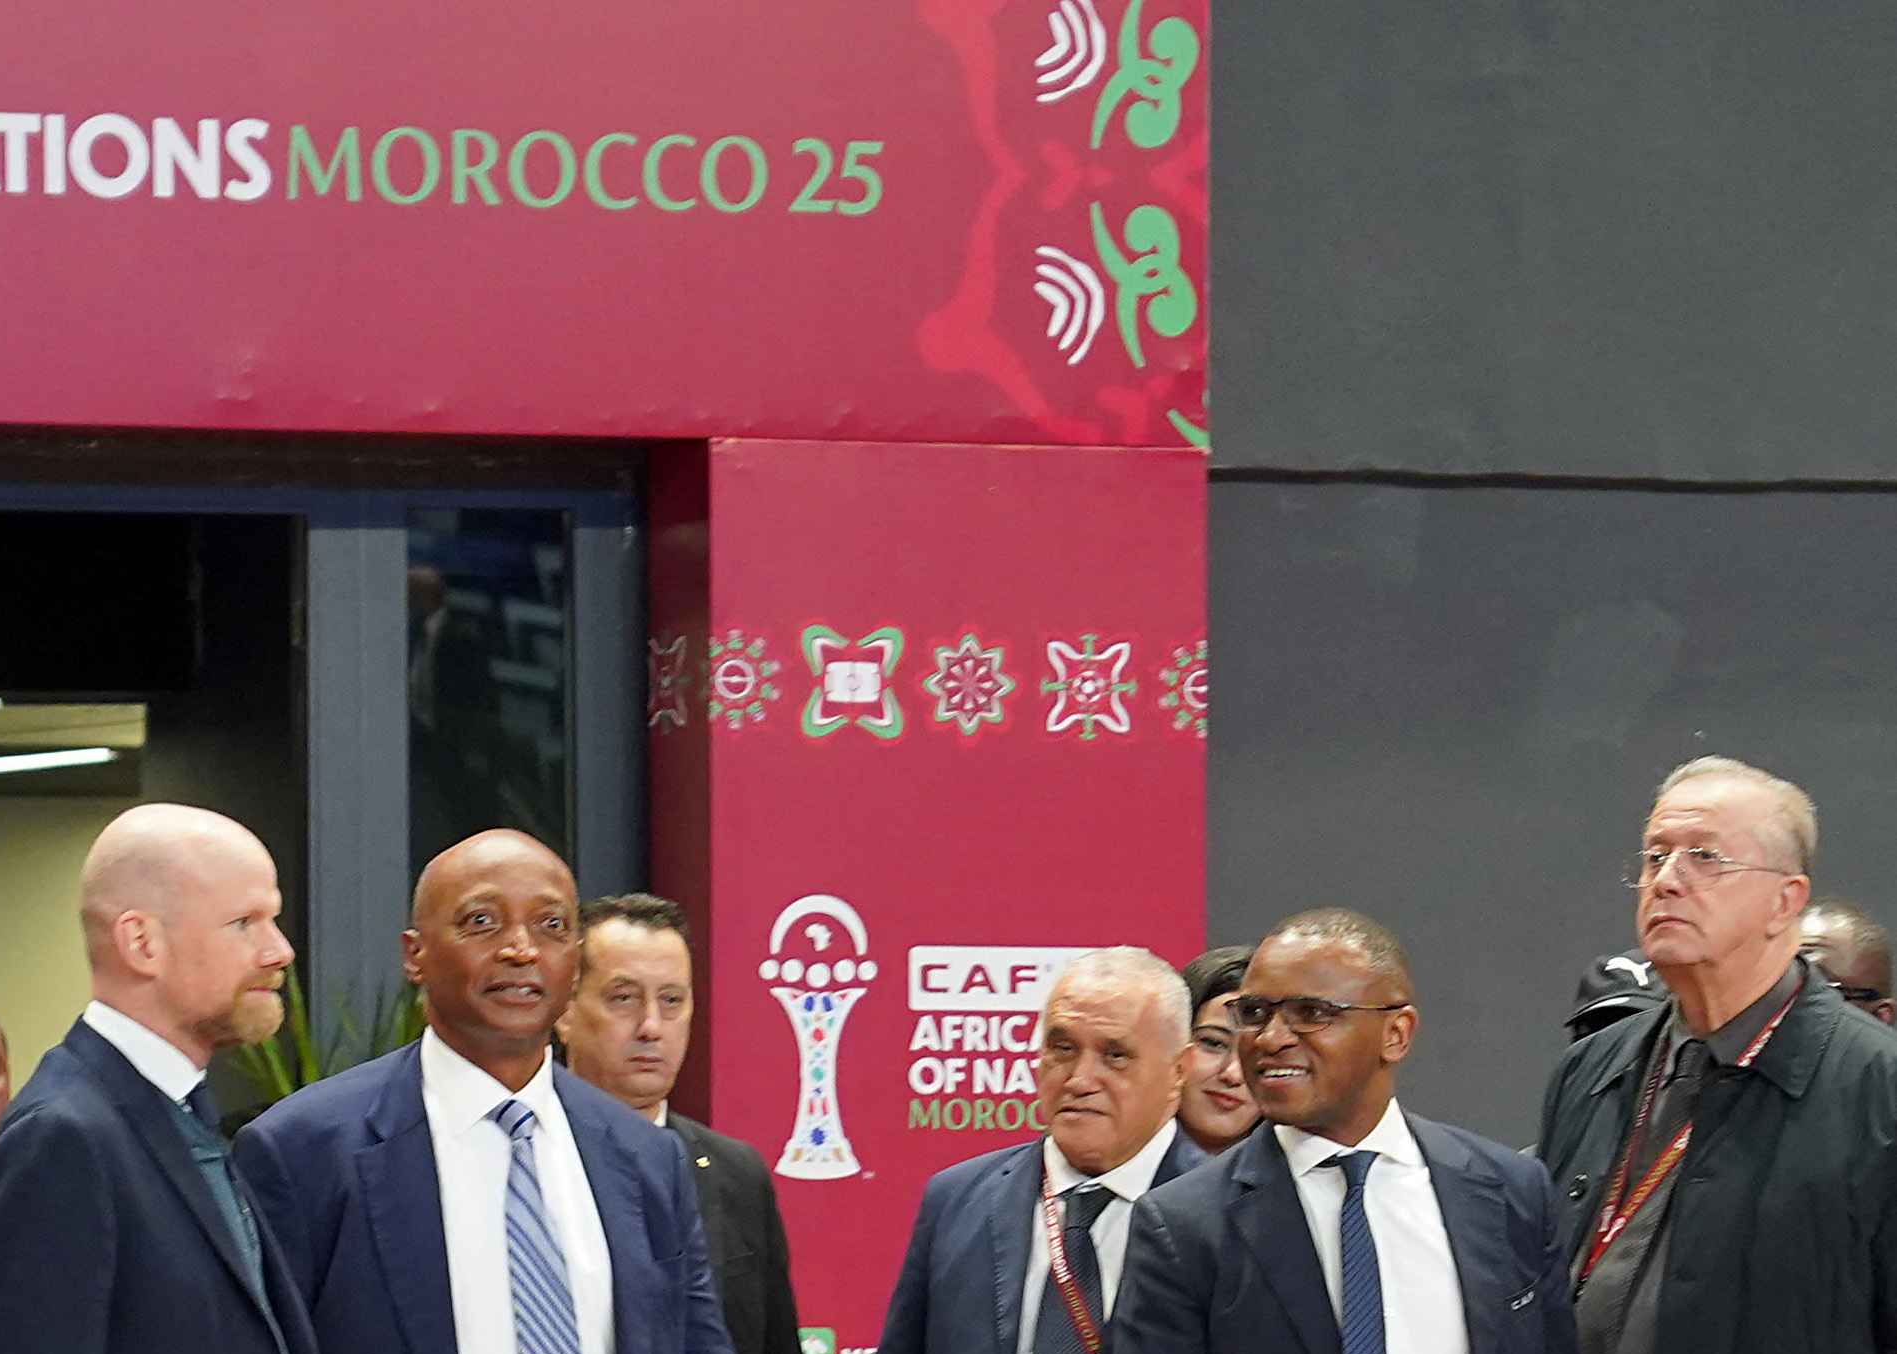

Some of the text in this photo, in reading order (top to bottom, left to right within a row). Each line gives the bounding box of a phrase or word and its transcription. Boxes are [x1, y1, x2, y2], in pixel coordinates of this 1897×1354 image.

[285, 124, 769, 214] MOROCCO
[788, 137, 884, 216] 25
[908, 1056, 967, 1095] OF
